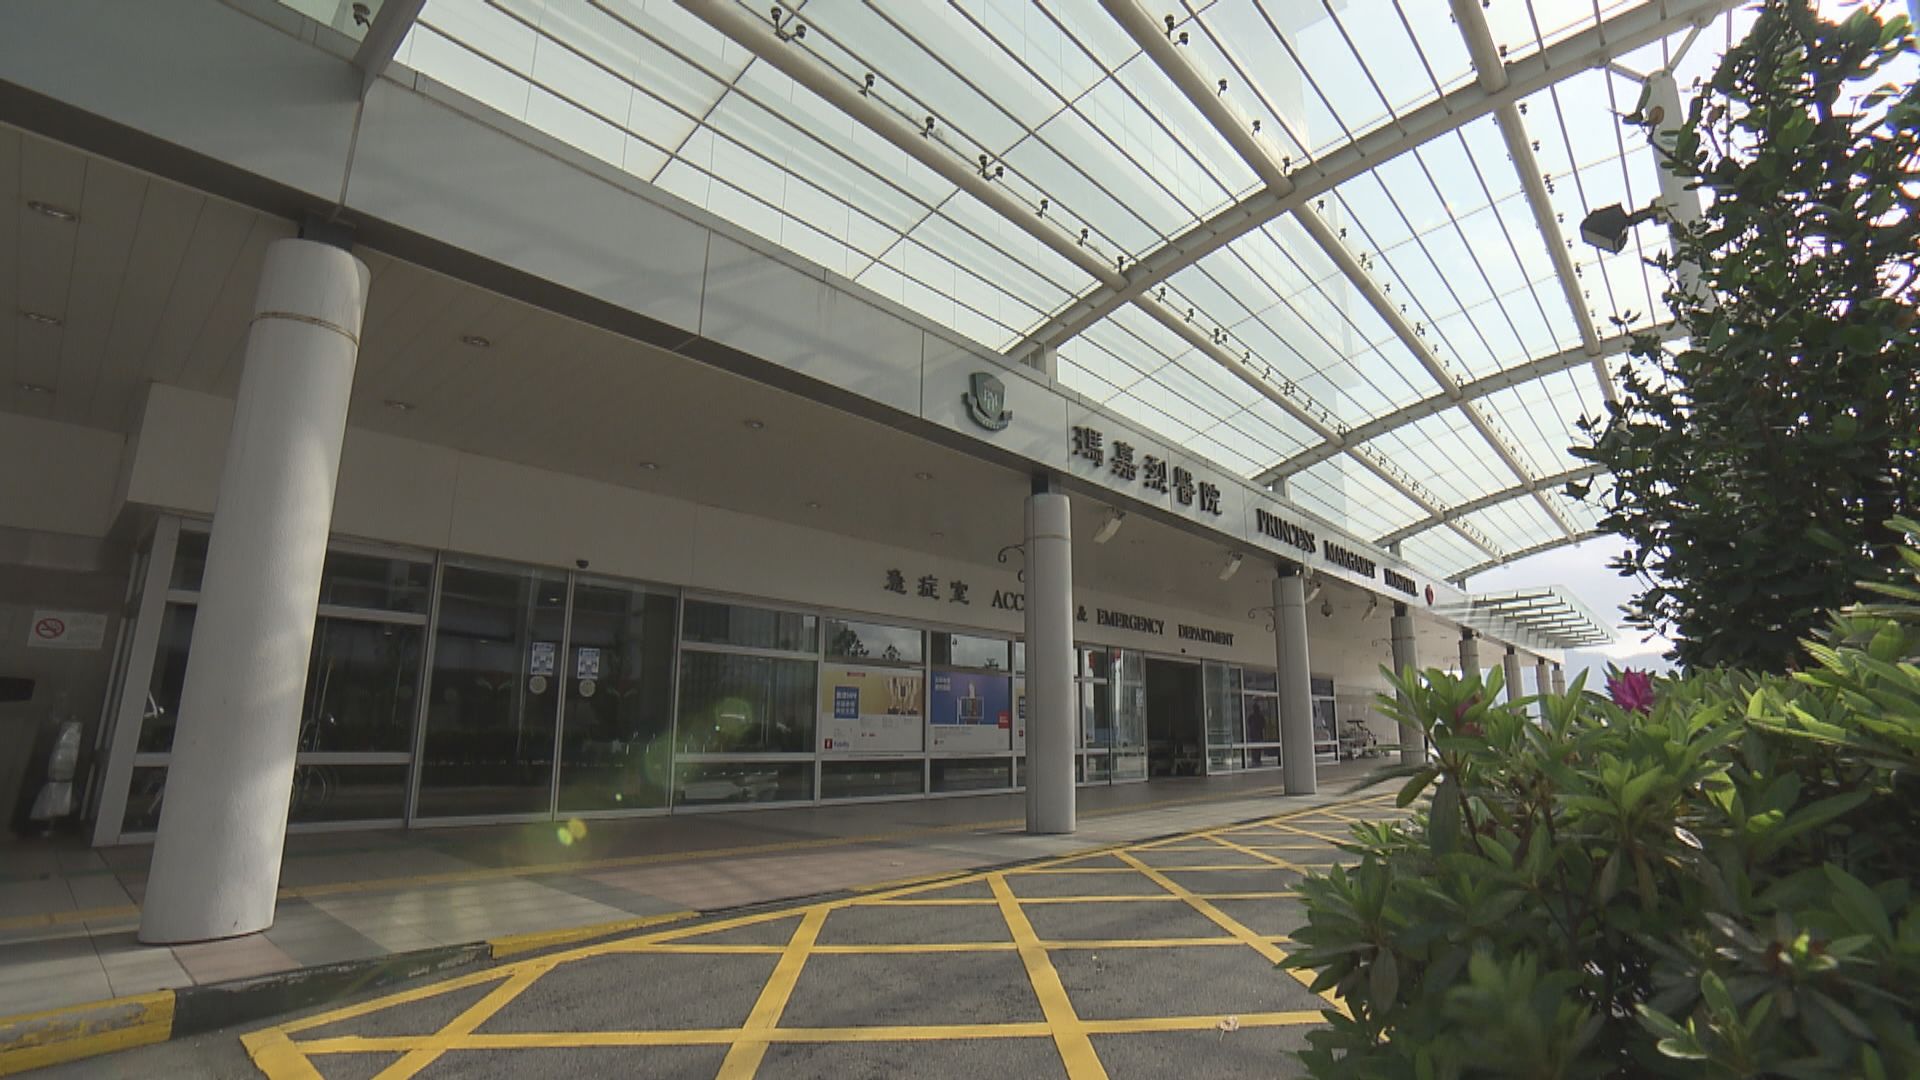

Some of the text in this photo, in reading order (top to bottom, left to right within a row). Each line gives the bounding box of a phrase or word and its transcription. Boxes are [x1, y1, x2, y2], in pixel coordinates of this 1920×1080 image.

[1073, 426, 1222, 514] 瑪嘉烈醫院
[1257, 509, 1419, 596] PRINCESS MARGARET HOSPITAL
[884, 569, 970, 605] 急症室
[1077, 605, 1234, 647] & EMERGENCY DEPARTMENT
